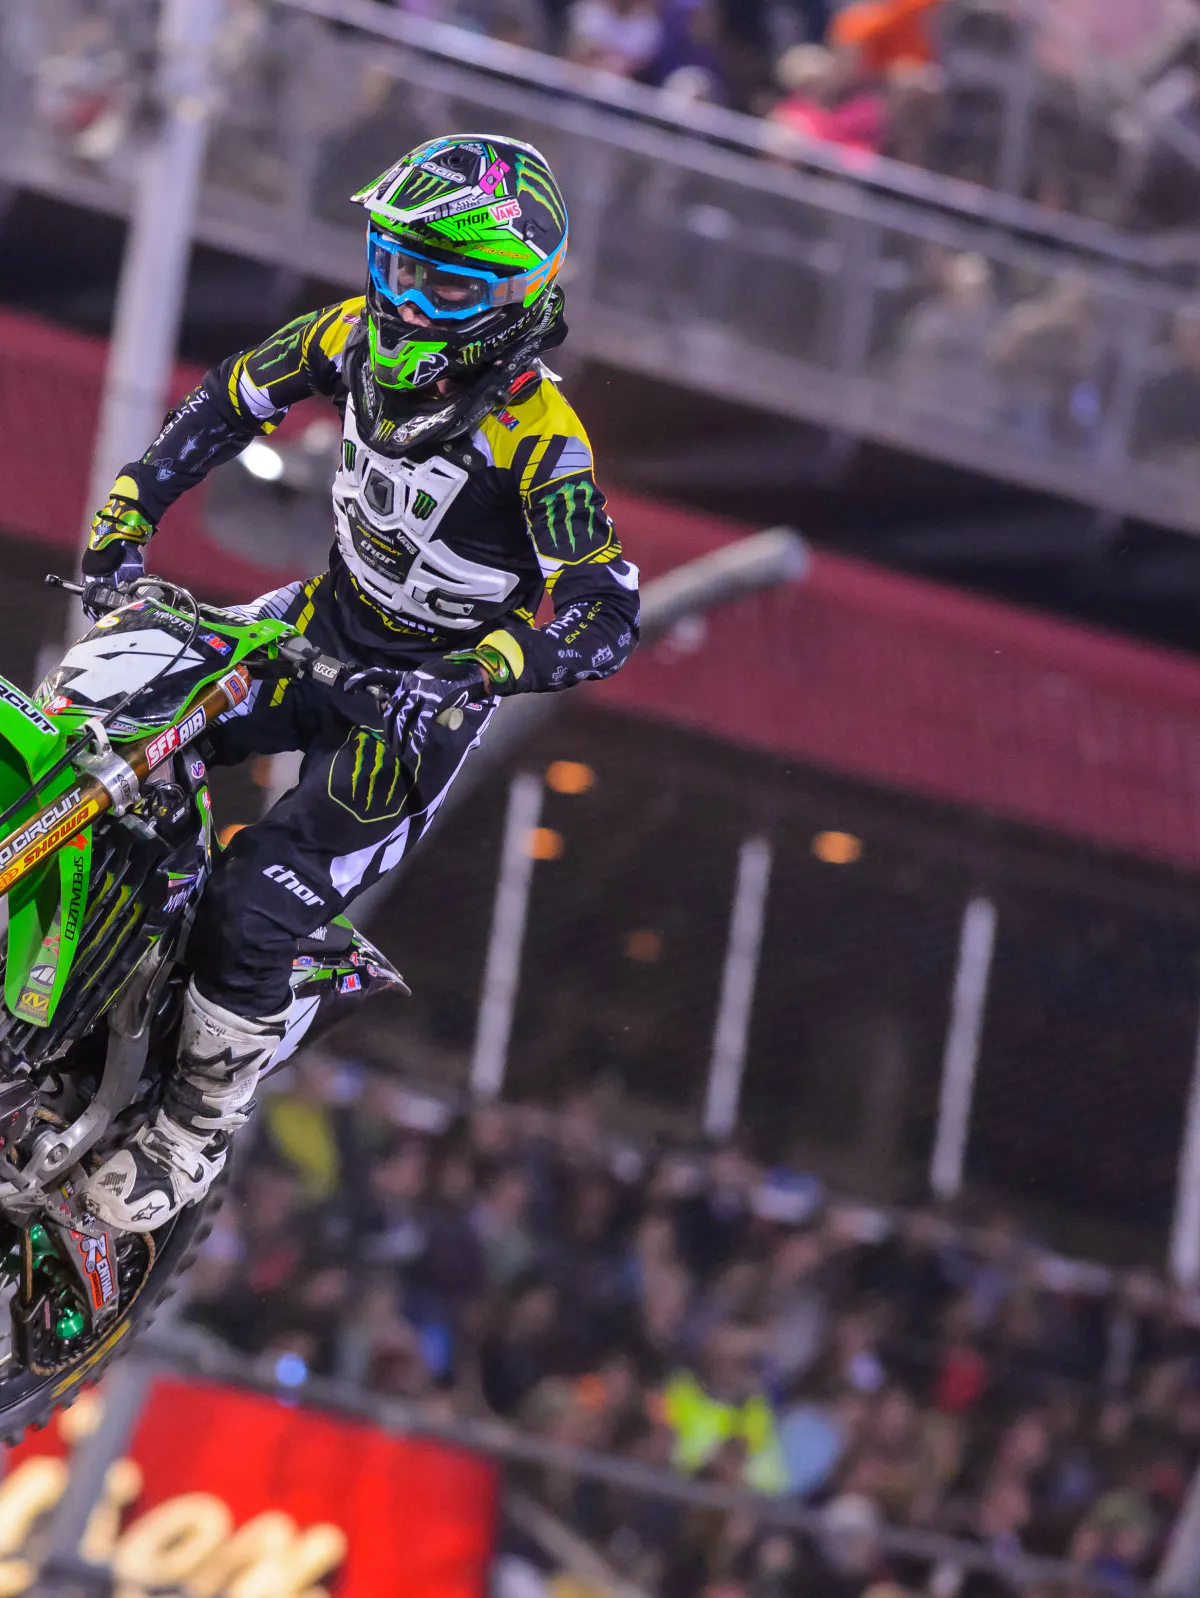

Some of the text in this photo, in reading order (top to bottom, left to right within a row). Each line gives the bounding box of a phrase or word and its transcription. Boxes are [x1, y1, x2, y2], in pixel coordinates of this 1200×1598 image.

[421, 162, 466, 184] OGIO
[454, 211, 489, 230] THOR
[488, 200, 521, 221] VANS
[360, 540, 397, 565] thor
[396, 531, 418, 556] VANS
[150, 710, 204, 765] SFF AIR
[12, 787, 82, 853] CIRCUIT
[23, 807, 89, 869] SHOWA
[64, 856, 84, 941] SPECIALIZED
[262, 864, 326, 906] thor
